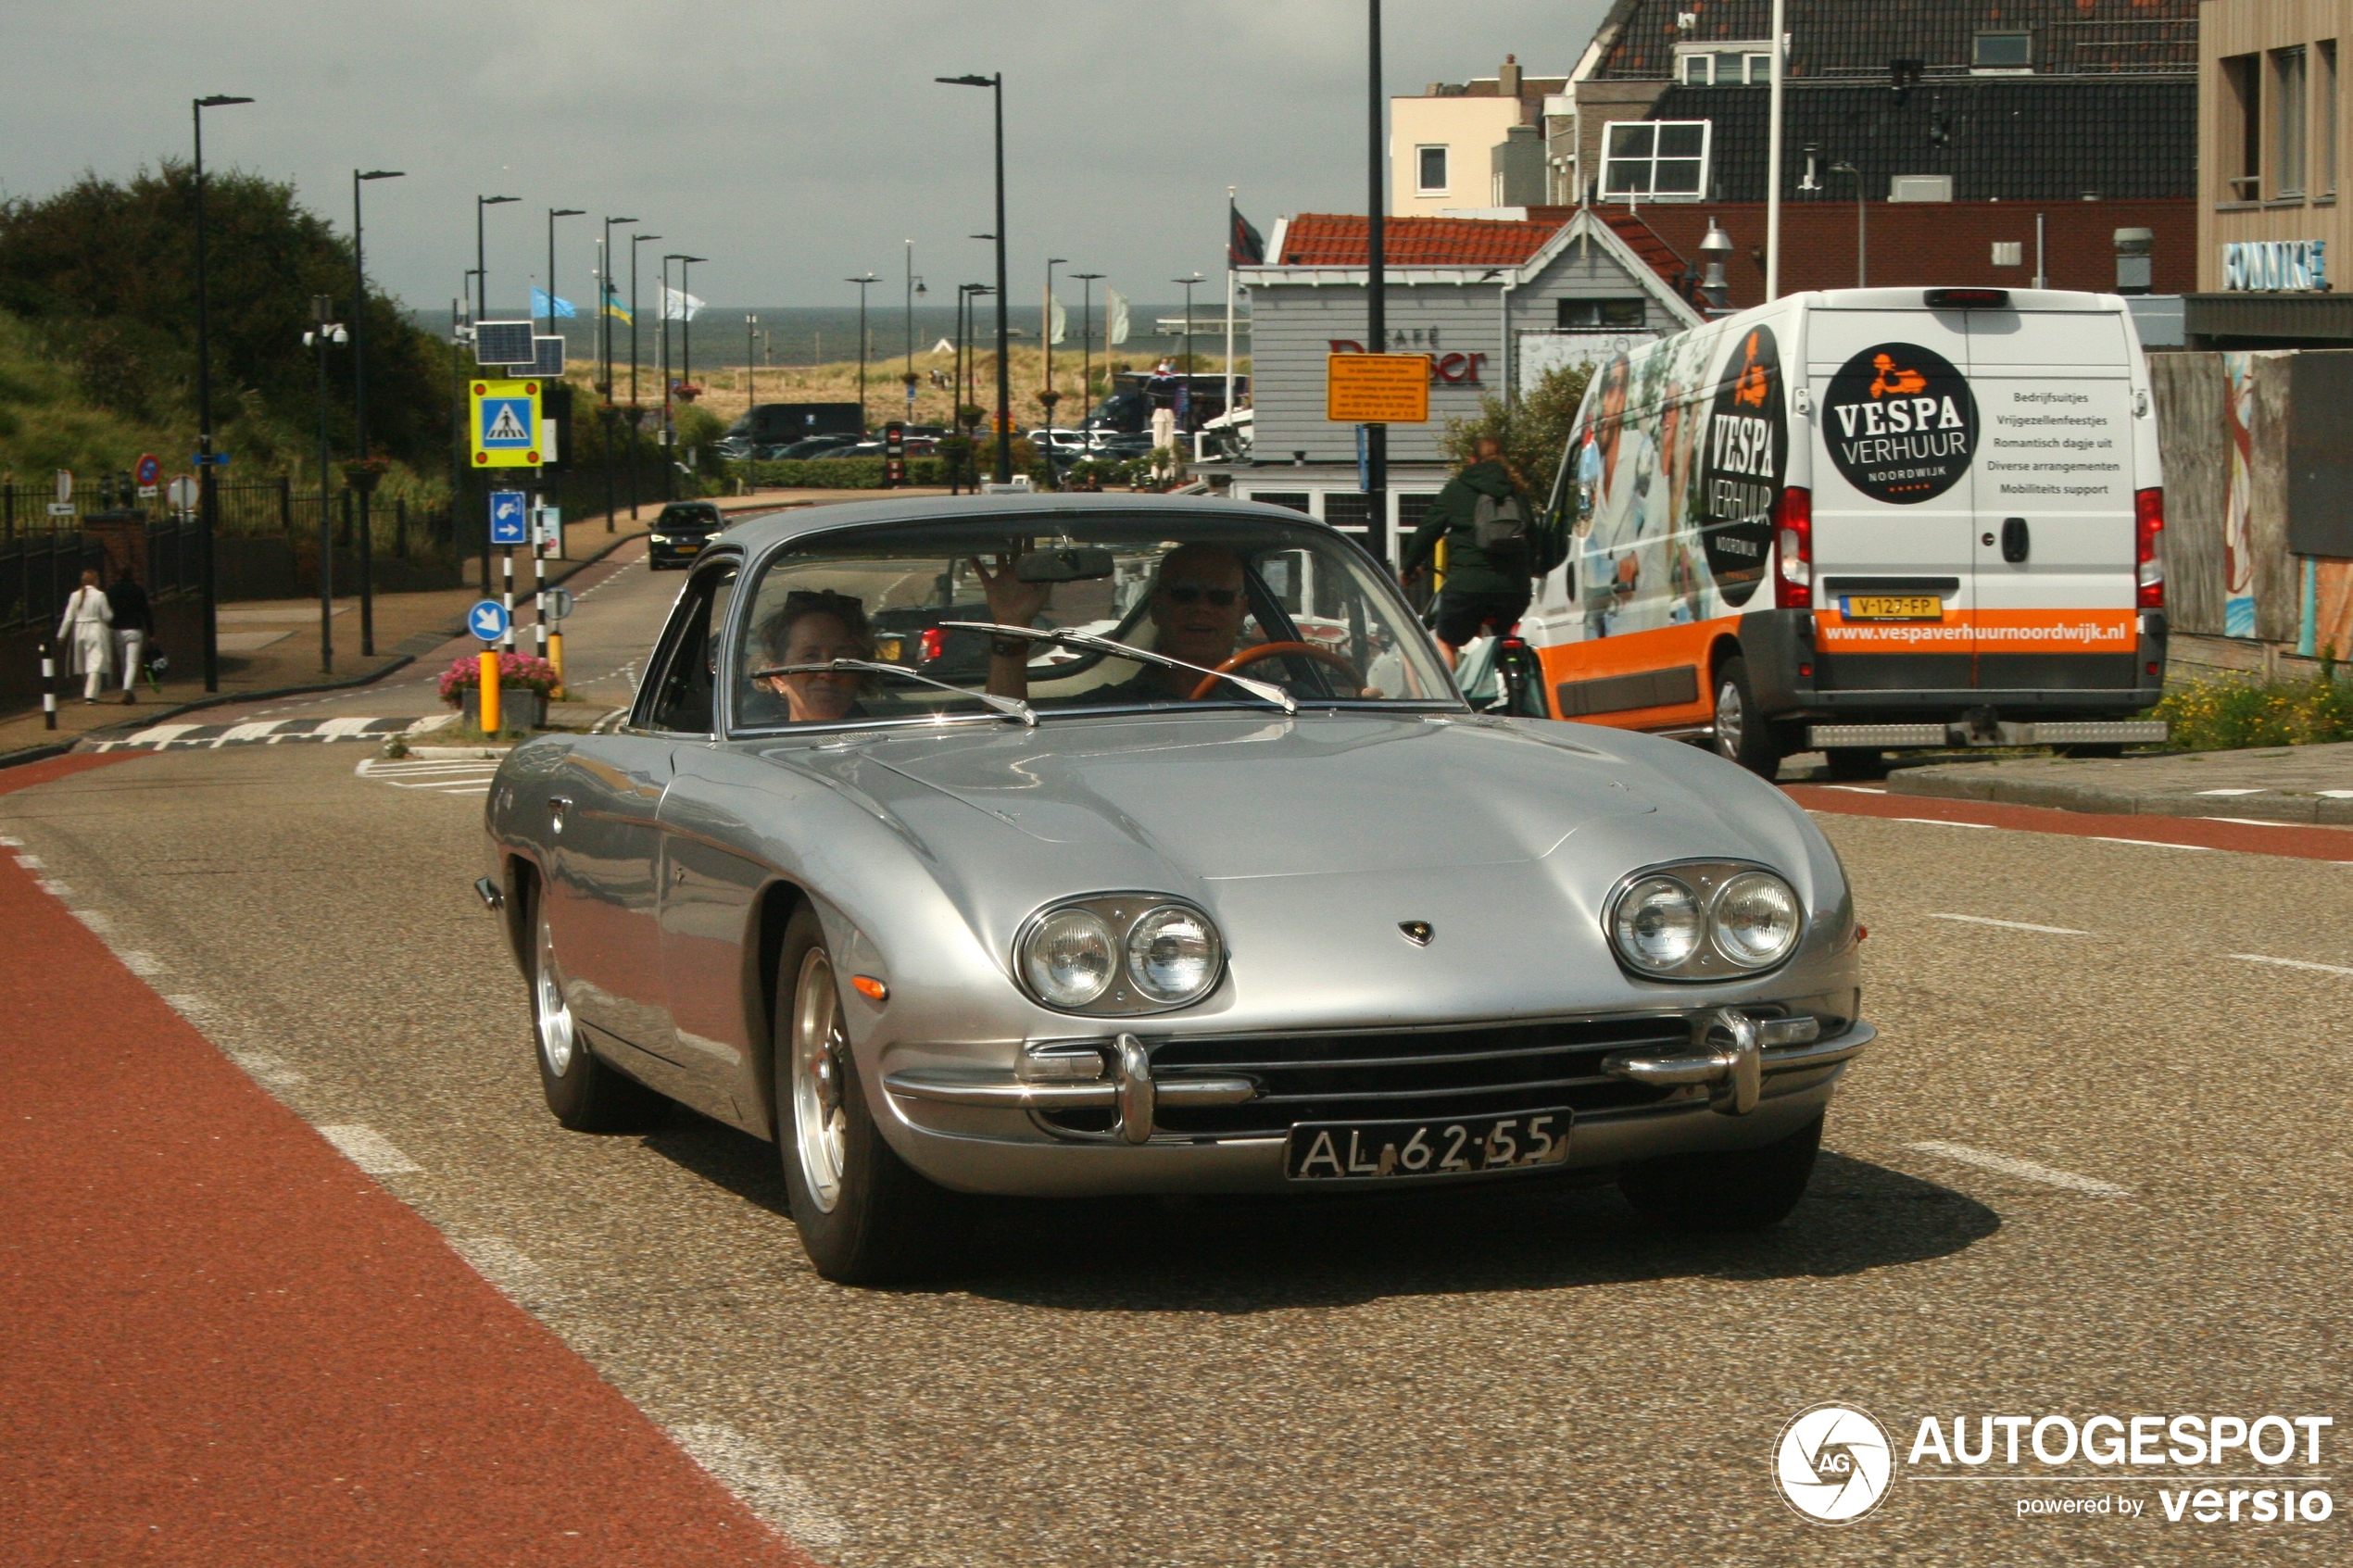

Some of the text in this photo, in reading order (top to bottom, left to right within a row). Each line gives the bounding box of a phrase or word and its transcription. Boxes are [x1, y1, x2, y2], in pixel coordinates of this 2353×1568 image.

[2013, 392, 2089, 405] Bedrijfsuitjes
[1834, 395, 1964, 438] VESPA
[1996, 415, 2108, 428] Vrijgezellenfeestjes
[1713, 414, 1774, 478] VESPA
[1842, 432, 1967, 465] VERHUUR
[1994, 438, 2112, 450] Romantisch dagje uit
[1869, 466, 1946, 483] NOORDWIJK
[1987, 460, 2120, 473] Diverse arrangementen
[2064, 484, 2108, 496] support
[1708, 477, 1771, 526] VERHUUR
[1858, 598, 1931, 613] V-127-FP
[1825, 621, 2126, 644] www.vespaverhuurnoordwijk.nl
